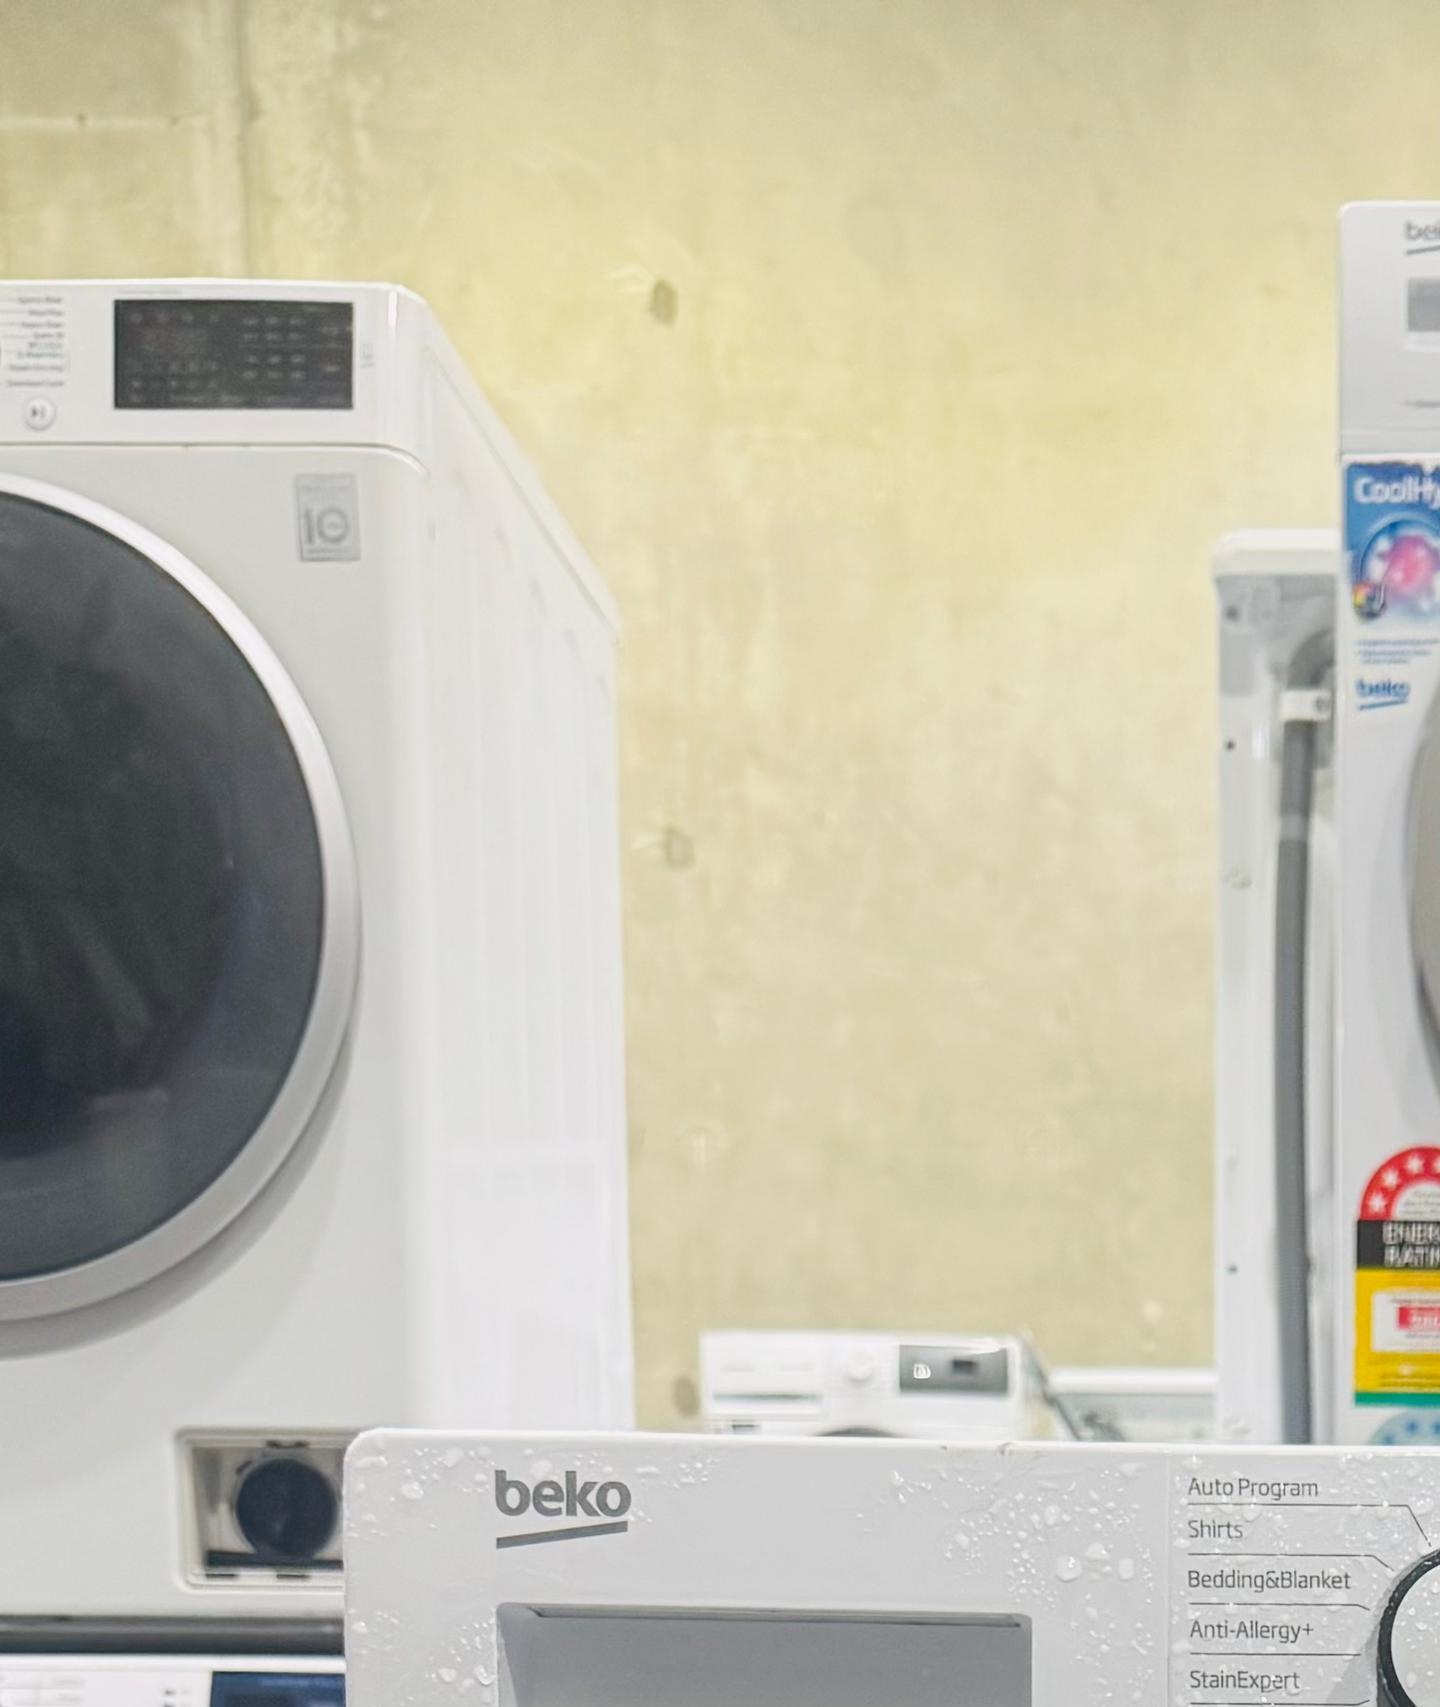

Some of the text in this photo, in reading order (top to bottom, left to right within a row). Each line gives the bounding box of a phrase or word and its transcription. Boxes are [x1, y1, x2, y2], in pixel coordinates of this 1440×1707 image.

[1356, 678, 1410, 698] beko
[495, 1469, 632, 1518] beko
[1187, 1477, 1319, 1501] Auto Program
[1187, 1520, 1244, 1539] Shirts
[1188, 1570, 1352, 1593] Bedding&Blanket
[1190, 1619, 1314, 1643] Anti-Allergy+
[1190, 1670, 1301, 1692] StainExpert
